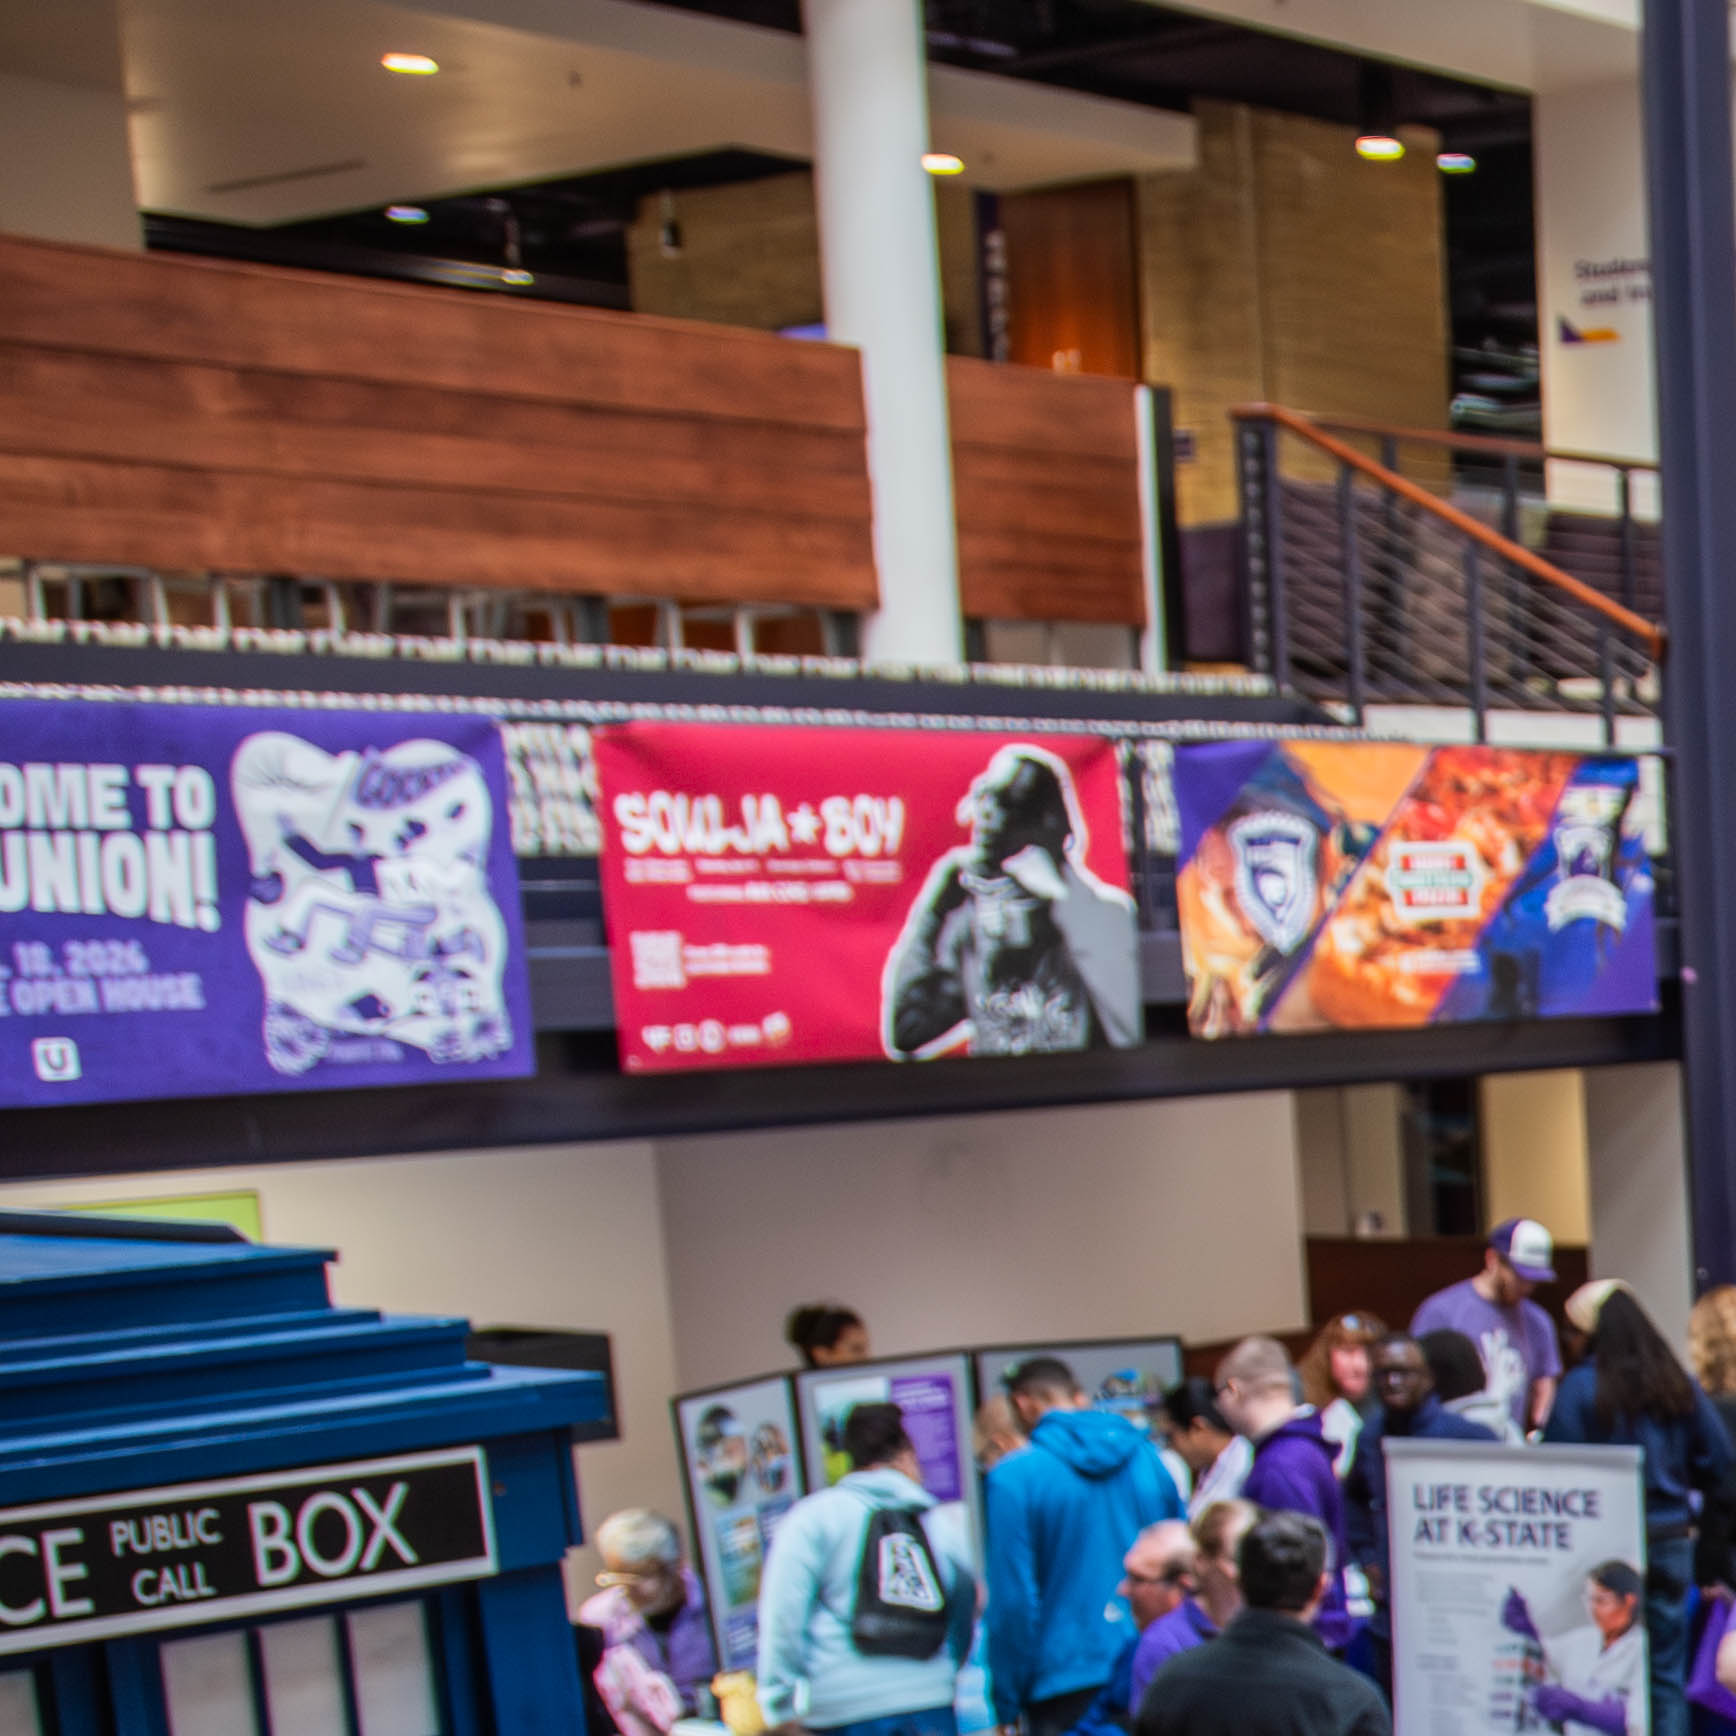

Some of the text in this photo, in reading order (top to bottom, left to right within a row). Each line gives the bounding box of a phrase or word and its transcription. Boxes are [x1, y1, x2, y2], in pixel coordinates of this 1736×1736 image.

[136, 764, 217, 830] TO
[613, 790, 905, 857] SOULJA BOY
[10, 972, 207, 1015] OPEN HOUSE
[1412, 1484, 1600, 1519] LIFE SCIENCE
[0, 1482, 419, 1626] CE BOX
[110, 1507, 223, 1558] PUBLIC
[1413, 1518, 1573, 1551] AT K-STATE
[131, 1562, 216, 1607] CALL
